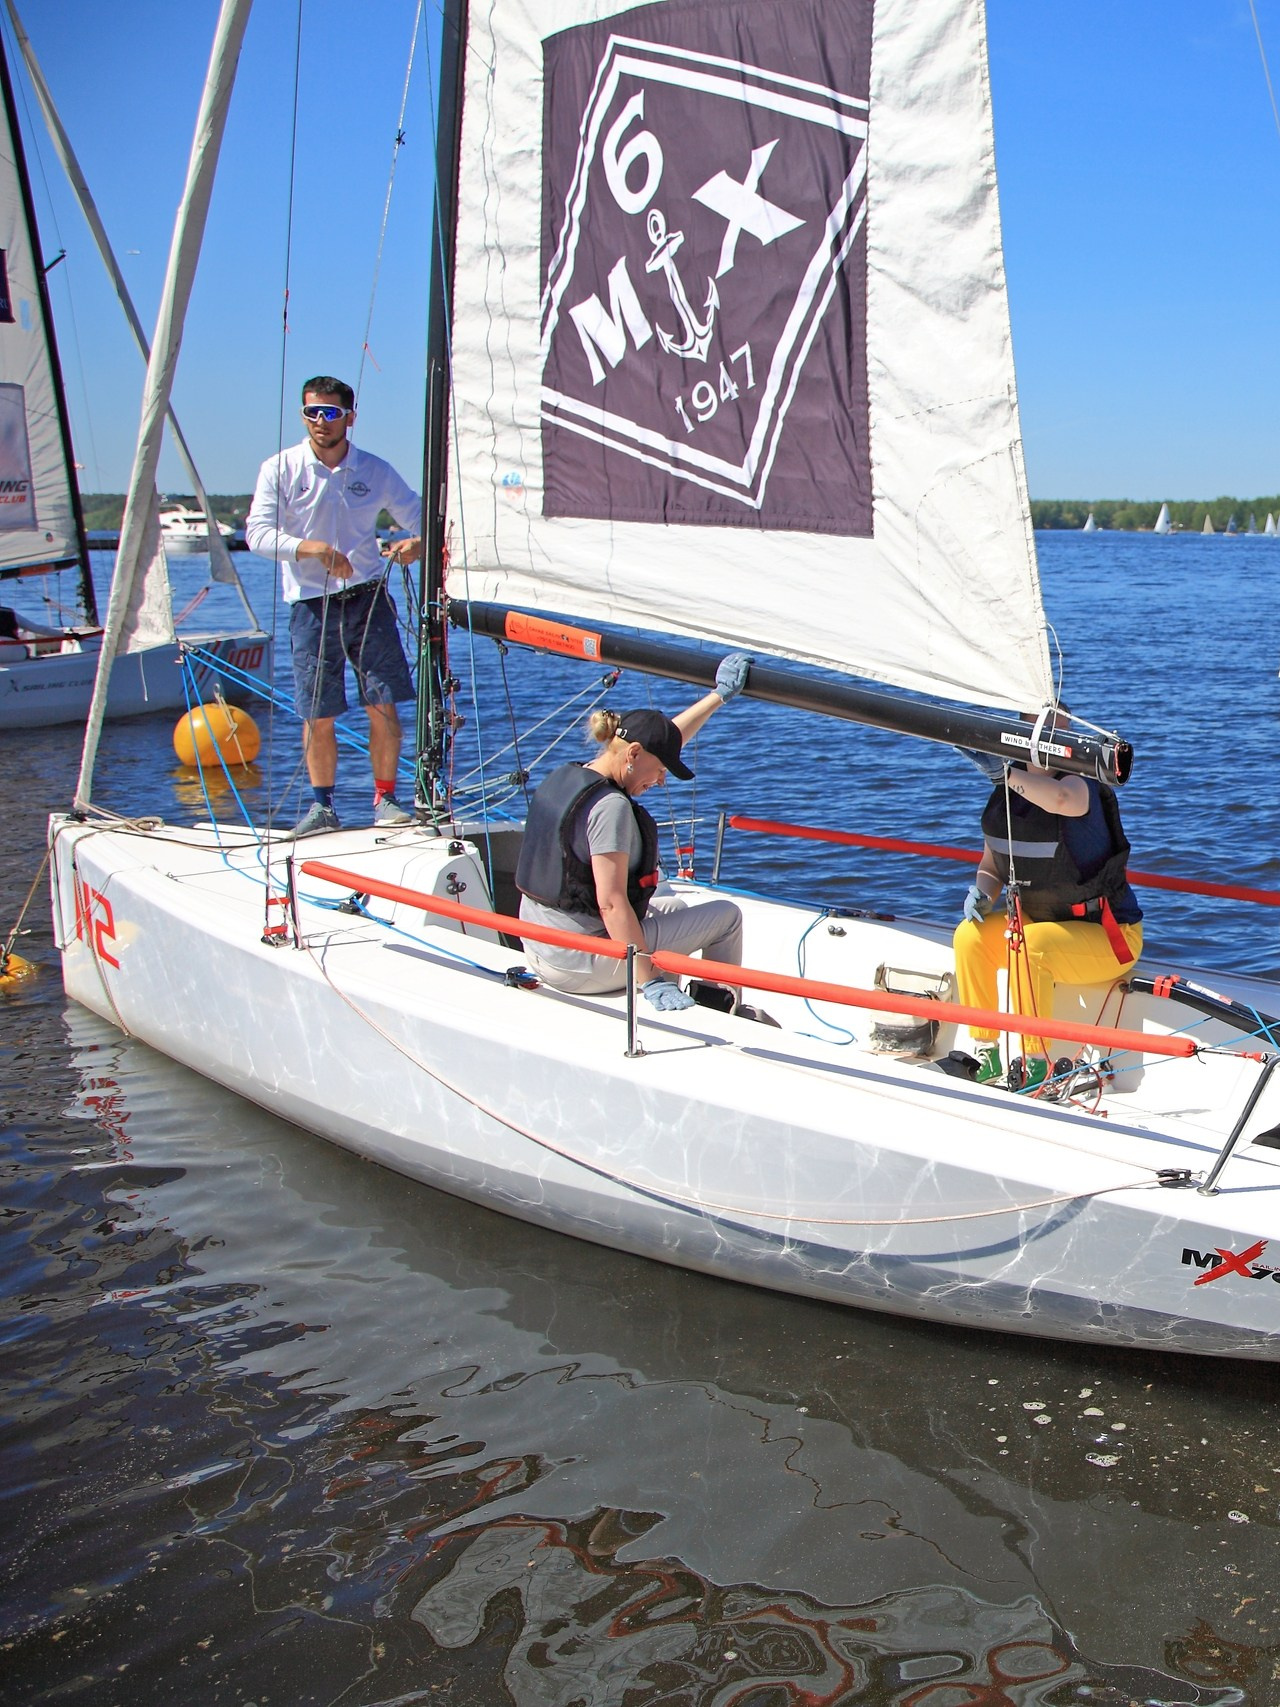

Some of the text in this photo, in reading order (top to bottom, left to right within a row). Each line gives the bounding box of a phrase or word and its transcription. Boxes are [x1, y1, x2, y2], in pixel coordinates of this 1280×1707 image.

[602, 89, 663, 214] 6
[568, 255, 653, 387] M
[675, 341, 758, 433] 1947
[1004, 735, 1062, 754] WIND BTHERS
